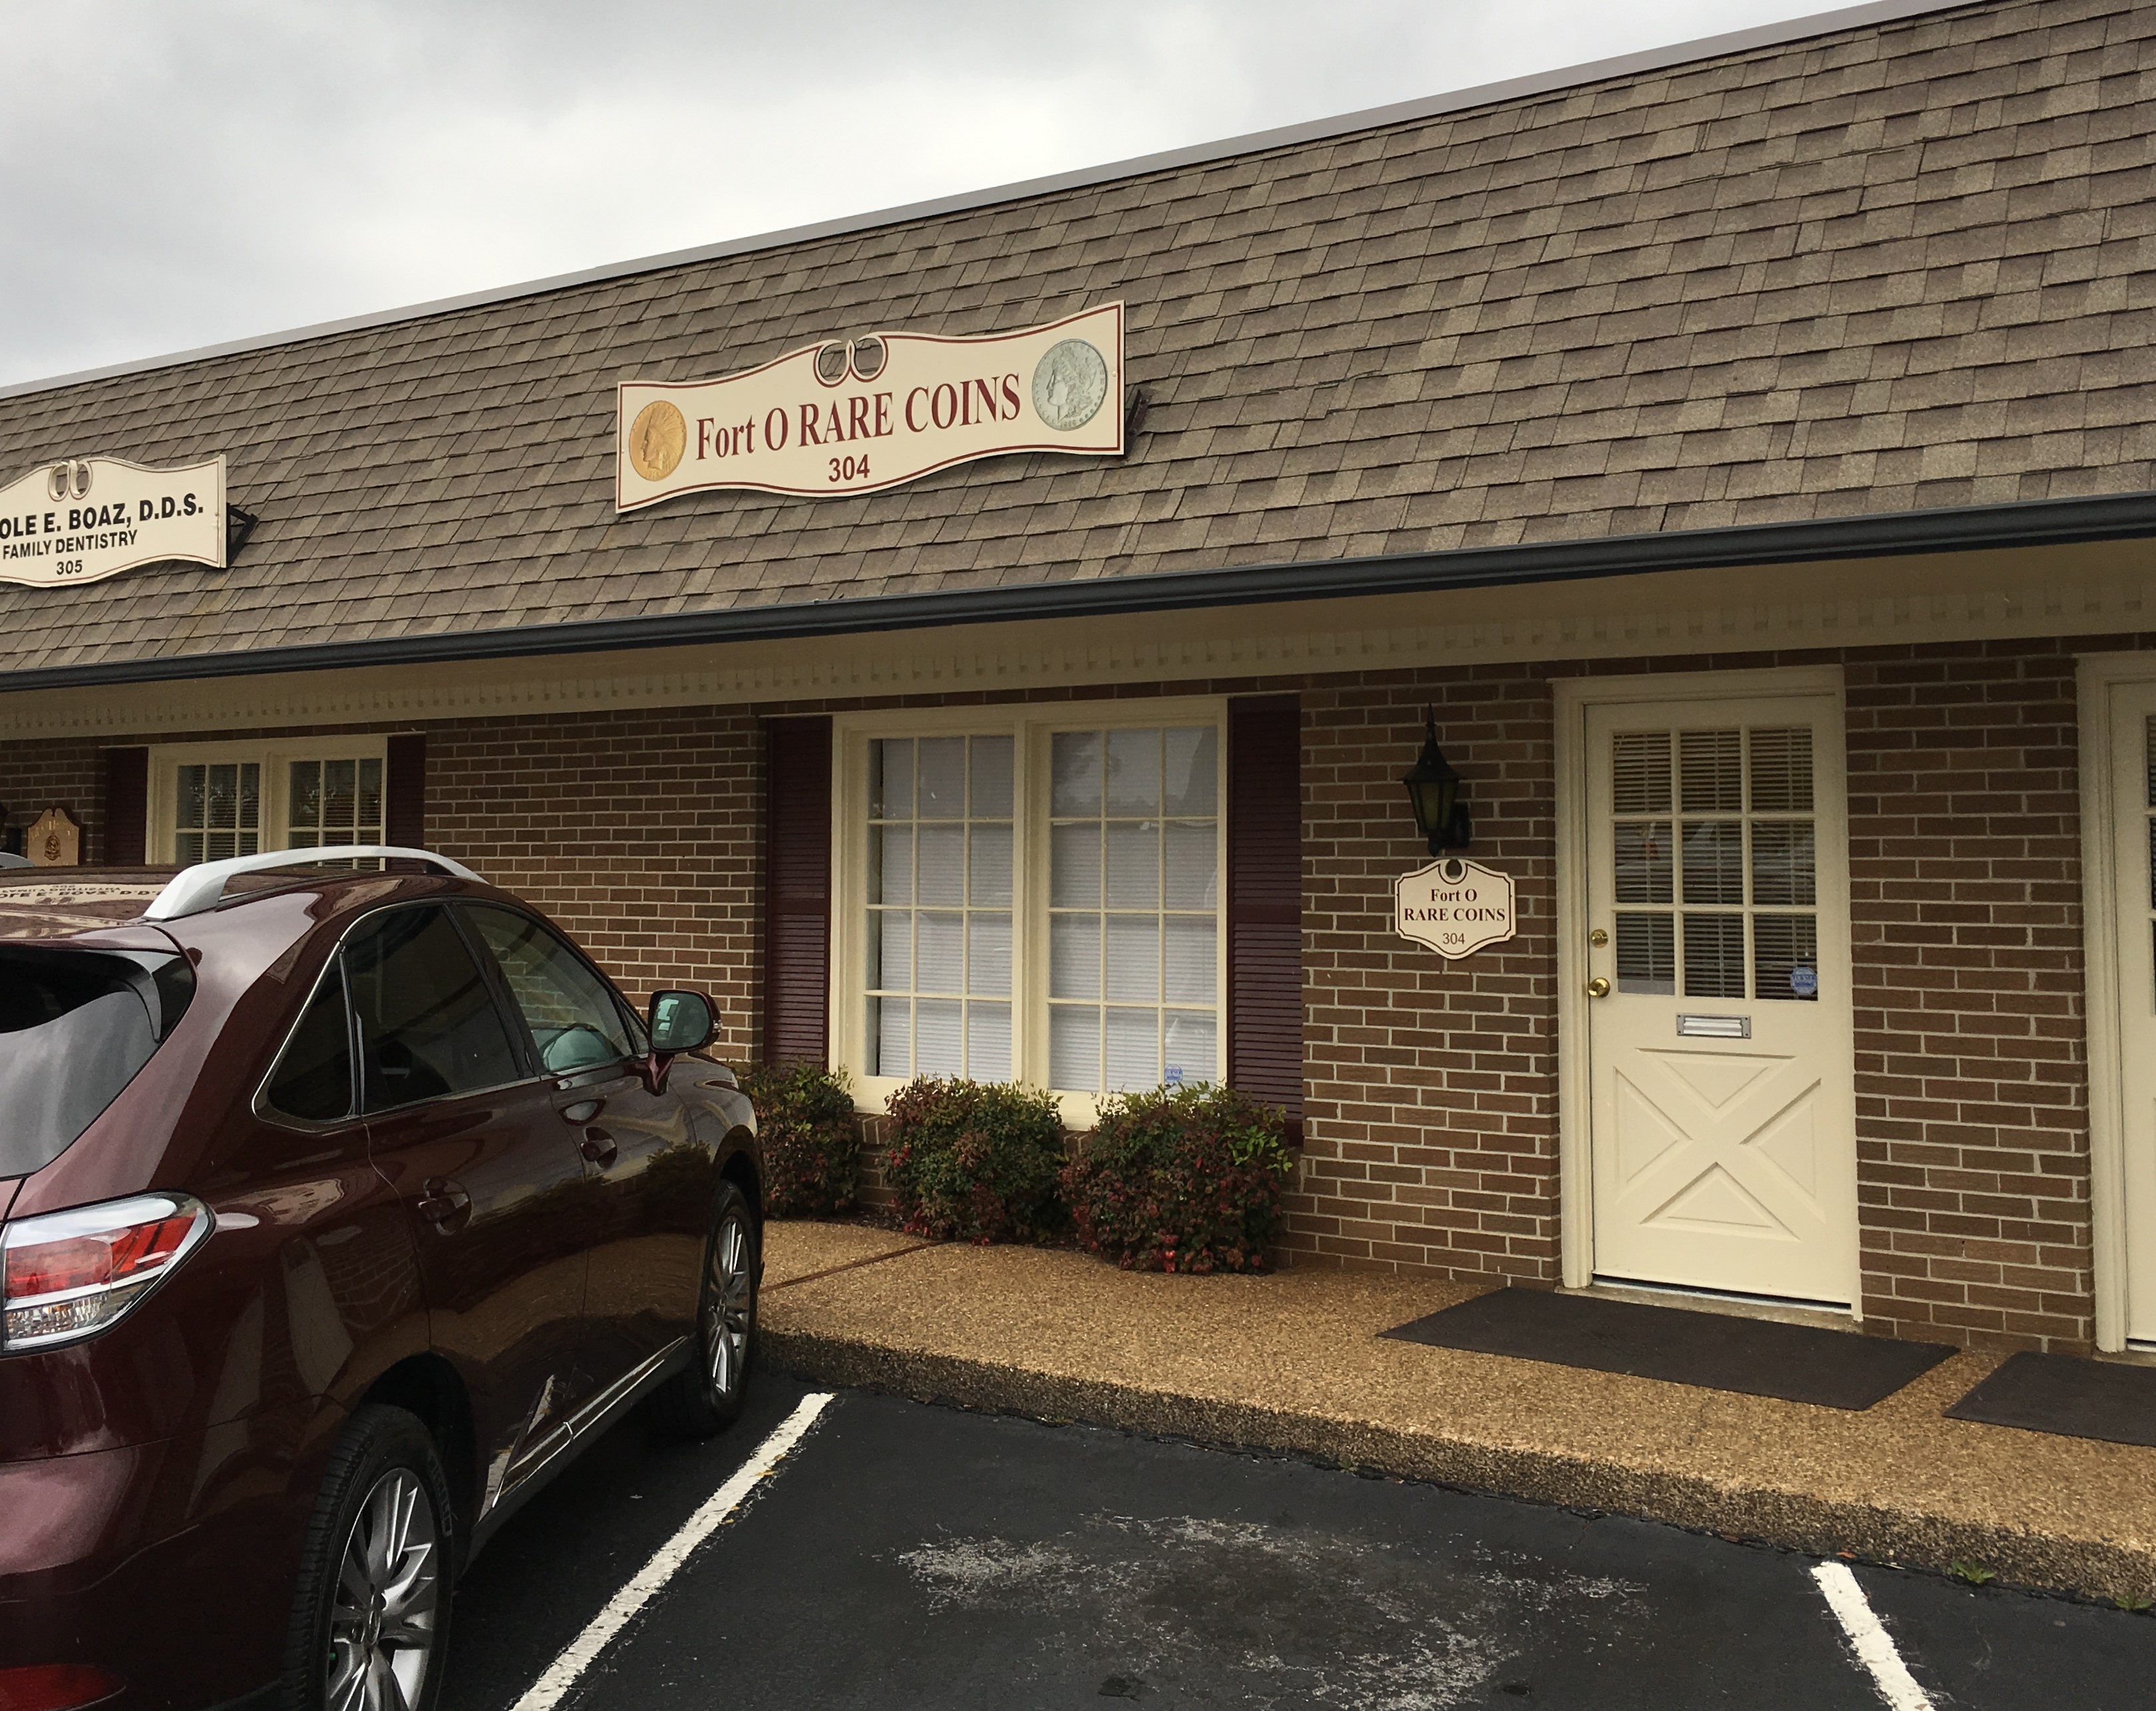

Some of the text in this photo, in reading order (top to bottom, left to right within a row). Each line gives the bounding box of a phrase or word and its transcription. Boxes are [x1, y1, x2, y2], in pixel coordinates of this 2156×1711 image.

[695, 373, 1022, 461] Fort O RARE COINS
[828, 453, 870, 482] 304
[43, 512, 62, 533] E.
[69, 502, 132, 530] BOAZ,
[138, 492, 204, 522] D.D.S.
[3, 529, 138, 560] FAMILY DENTISTRY
[56, 559, 83, 576] 305
[1431, 888, 1477, 902] Fort O
[1404, 908, 1506, 922] RARE COINS
[1442, 932, 1465, 945] 304
